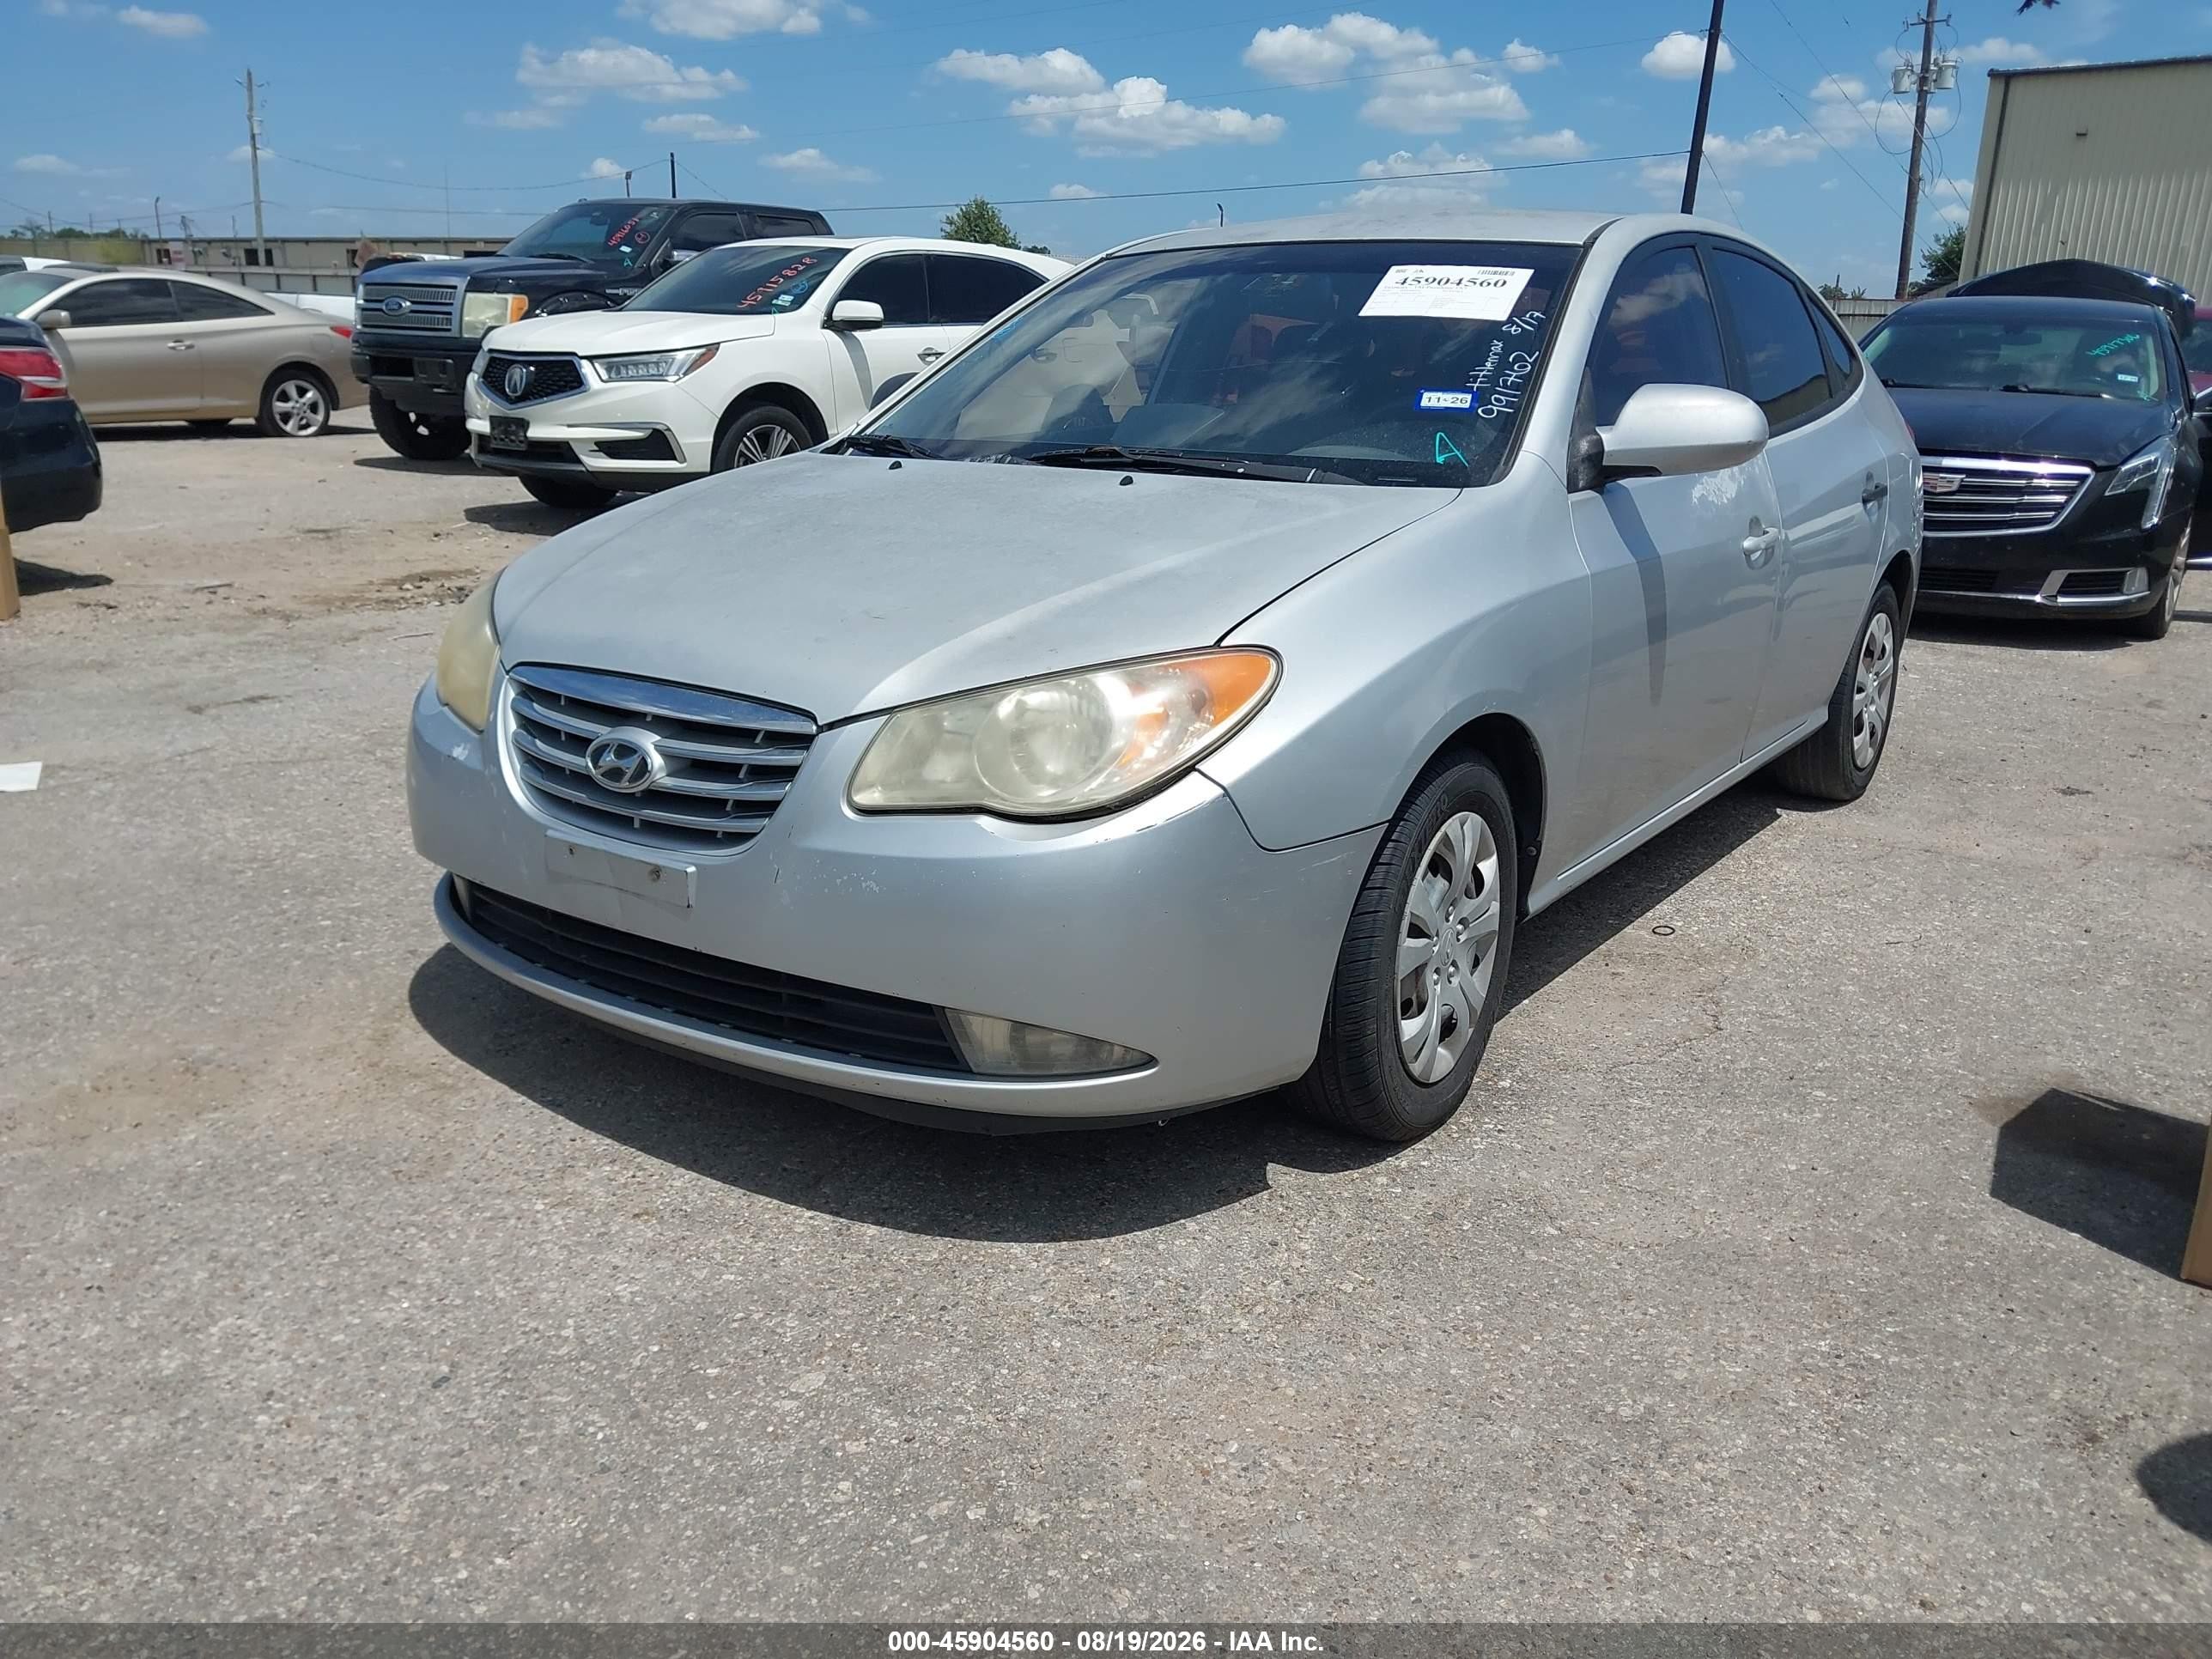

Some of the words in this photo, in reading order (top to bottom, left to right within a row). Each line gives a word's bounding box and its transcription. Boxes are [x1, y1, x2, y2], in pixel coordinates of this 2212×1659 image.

[1395, 276, 1508, 288] 45904560
[1502, 310, 1547, 335] 8/17
[1477, 350, 1540, 418] 991762
